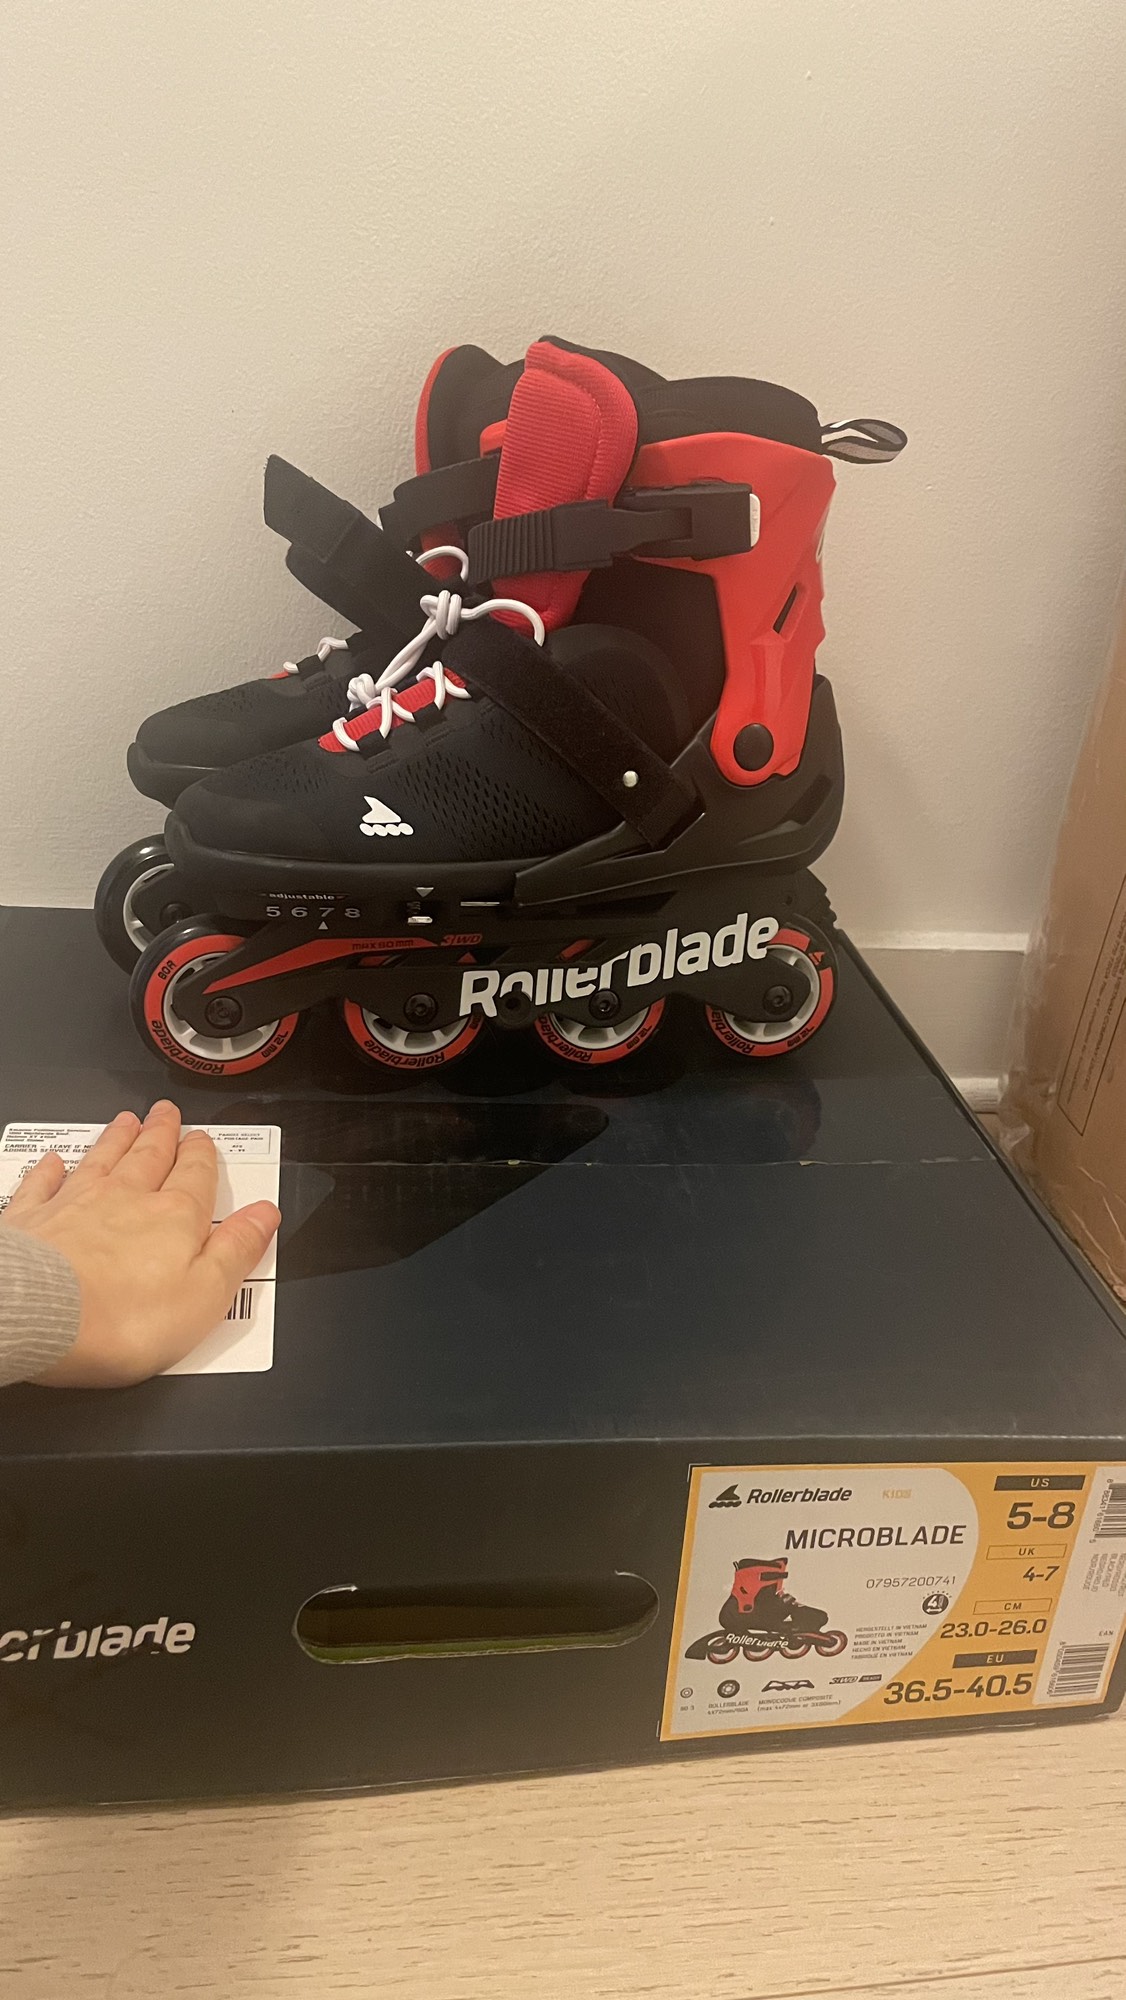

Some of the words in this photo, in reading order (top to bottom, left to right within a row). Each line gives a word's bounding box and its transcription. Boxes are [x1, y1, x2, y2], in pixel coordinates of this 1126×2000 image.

[268, 892, 335, 901] adjustable
[266, 906, 281, 918] 5
[291, 906, 308, 918] 6
[319, 907, 335, 918] 7
[344, 908, 361, 918] 8
[152, 1020, 224, 1074] Rollerblade
[539, 1016, 592, 1062] Rollerblad
[364, 1040, 444, 1068] Rollerblade
[1030, 1478, 1050, 1488] US
[747, 1488, 852, 1504] Rollerblade
[882, 1489, 912, 1499] KIDS
[1006, 1502, 1076, 1530] 5-8
[785, 1525, 967, 1550] MICROBLADE
[1018, 1548, 1035, 1556] UK
[866, 1576, 956, 1588] 07957200741
[1022, 1566, 1060, 1582] 4-7
[1004, 1602, 1022, 1610] CM
[940, 1619, 1048, 1639] 23.0-26.0
[986, 1654, 1004, 1663] EU
[884, 1673, 1033, 1705] 36.5-40.5
